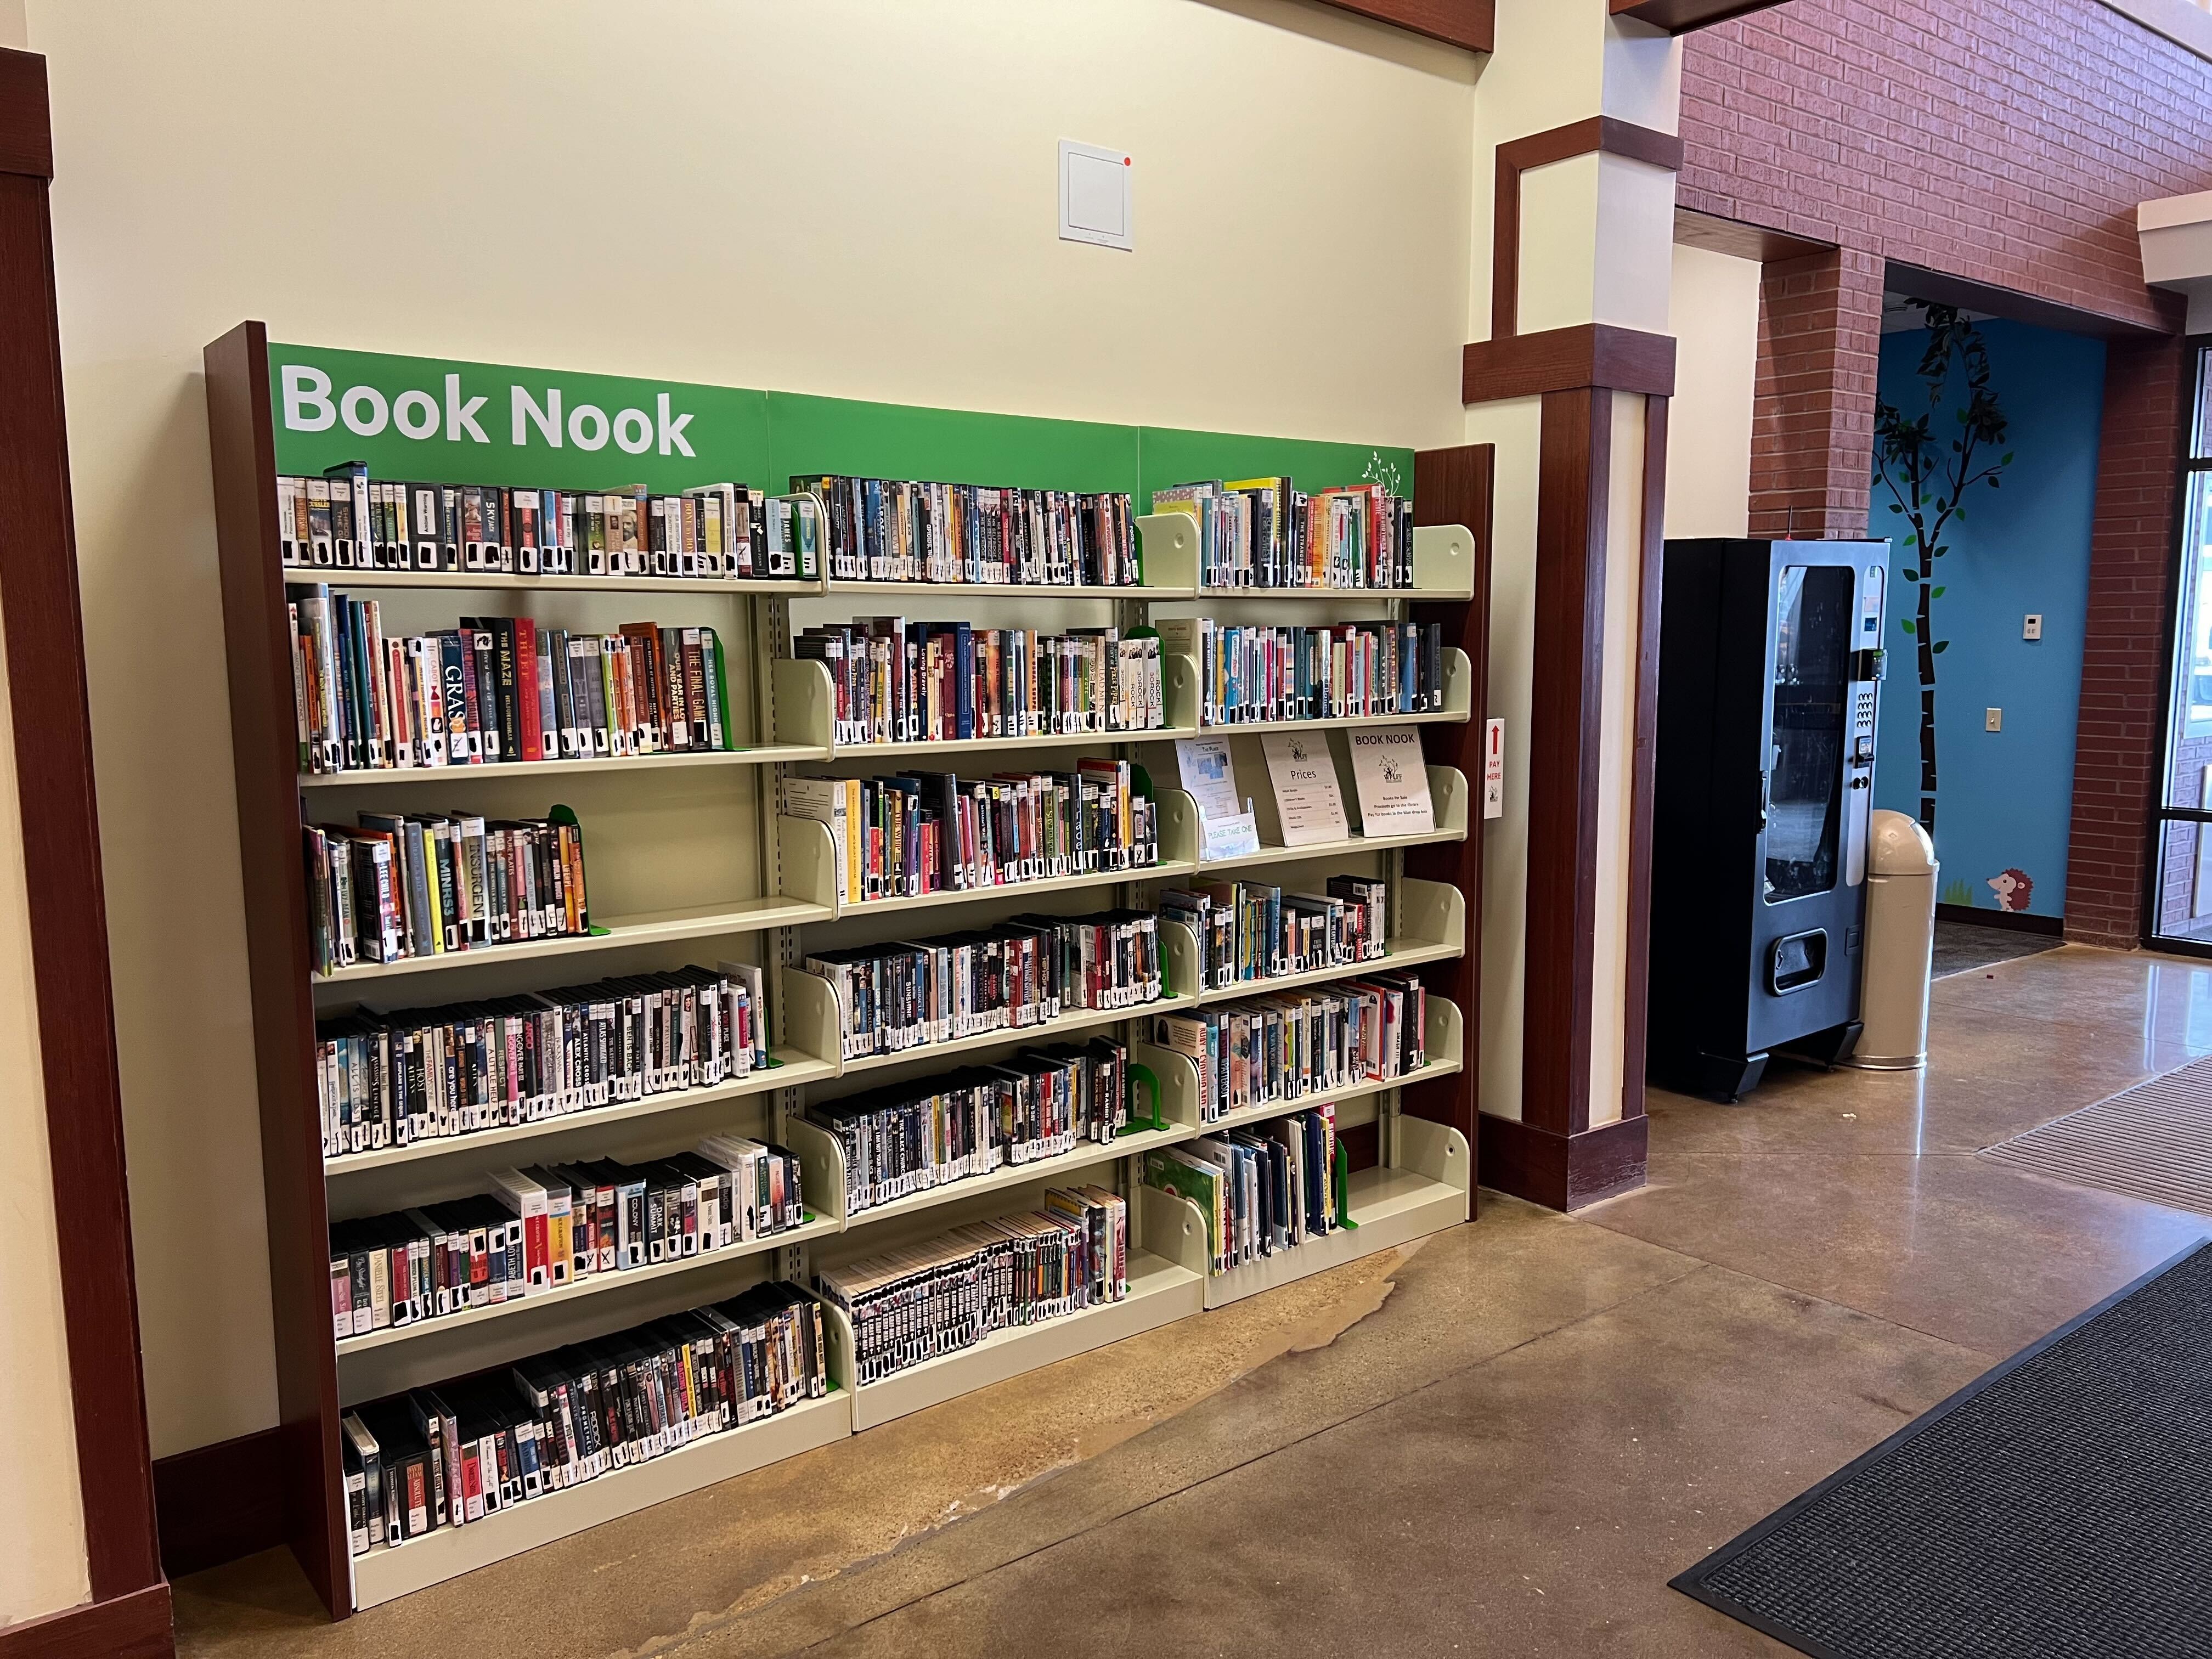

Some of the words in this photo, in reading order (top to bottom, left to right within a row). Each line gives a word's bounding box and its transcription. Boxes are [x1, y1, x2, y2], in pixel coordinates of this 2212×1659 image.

[282, 365, 490, 443] Book
[512, 385, 696, 457] Nook
[486, 502, 495, 532] SKYJACK
[980, 517, 985, 526] MR
[996, 522, 1001, 530] MR
[686, 527, 691, 535] BY
[519, 630, 529, 680] THIEF
[689, 650, 700, 667] THE
[500, 650, 512, 686] MAZE
[690, 670, 703, 695] FINAL
[445, 666, 464, 730] GRAS
[679, 697, 685, 706] IN
[1355, 735, 1384, 745] BOOK
[1385, 733, 1415, 744] NOOK
[1489, 760, 1500, 769] PAY
[1291, 770, 1317, 780] Prices
[1487, 772, 1501, 781] HERE
[1208, 831, 1226, 839] PLEASE
[1227, 827, 1240, 835] TAKE
[379, 866, 388, 879] LEE
[381, 879, 390, 898] CHILD
[440, 860, 454, 916] MINRS3
[371, 1056, 380, 1086] ASSASSINS
[416, 1068, 426, 1092] HOST
[353, 1084, 359, 1092] IS
[448, 1080, 456, 1096] you
[353, 1096, 361, 1120] LOST
[450, 1096, 458, 1112] here
[650, 1204, 658, 1234] SUMMIT
[374, 1253, 384, 1283] DANIELLE
[375, 1285, 385, 1304] STEEL
[677, 1362, 685, 1390] RAGING
[581, 1406, 592, 1455] PROMETHEUS
[590, 1412, 601, 1448] RIDDICK
